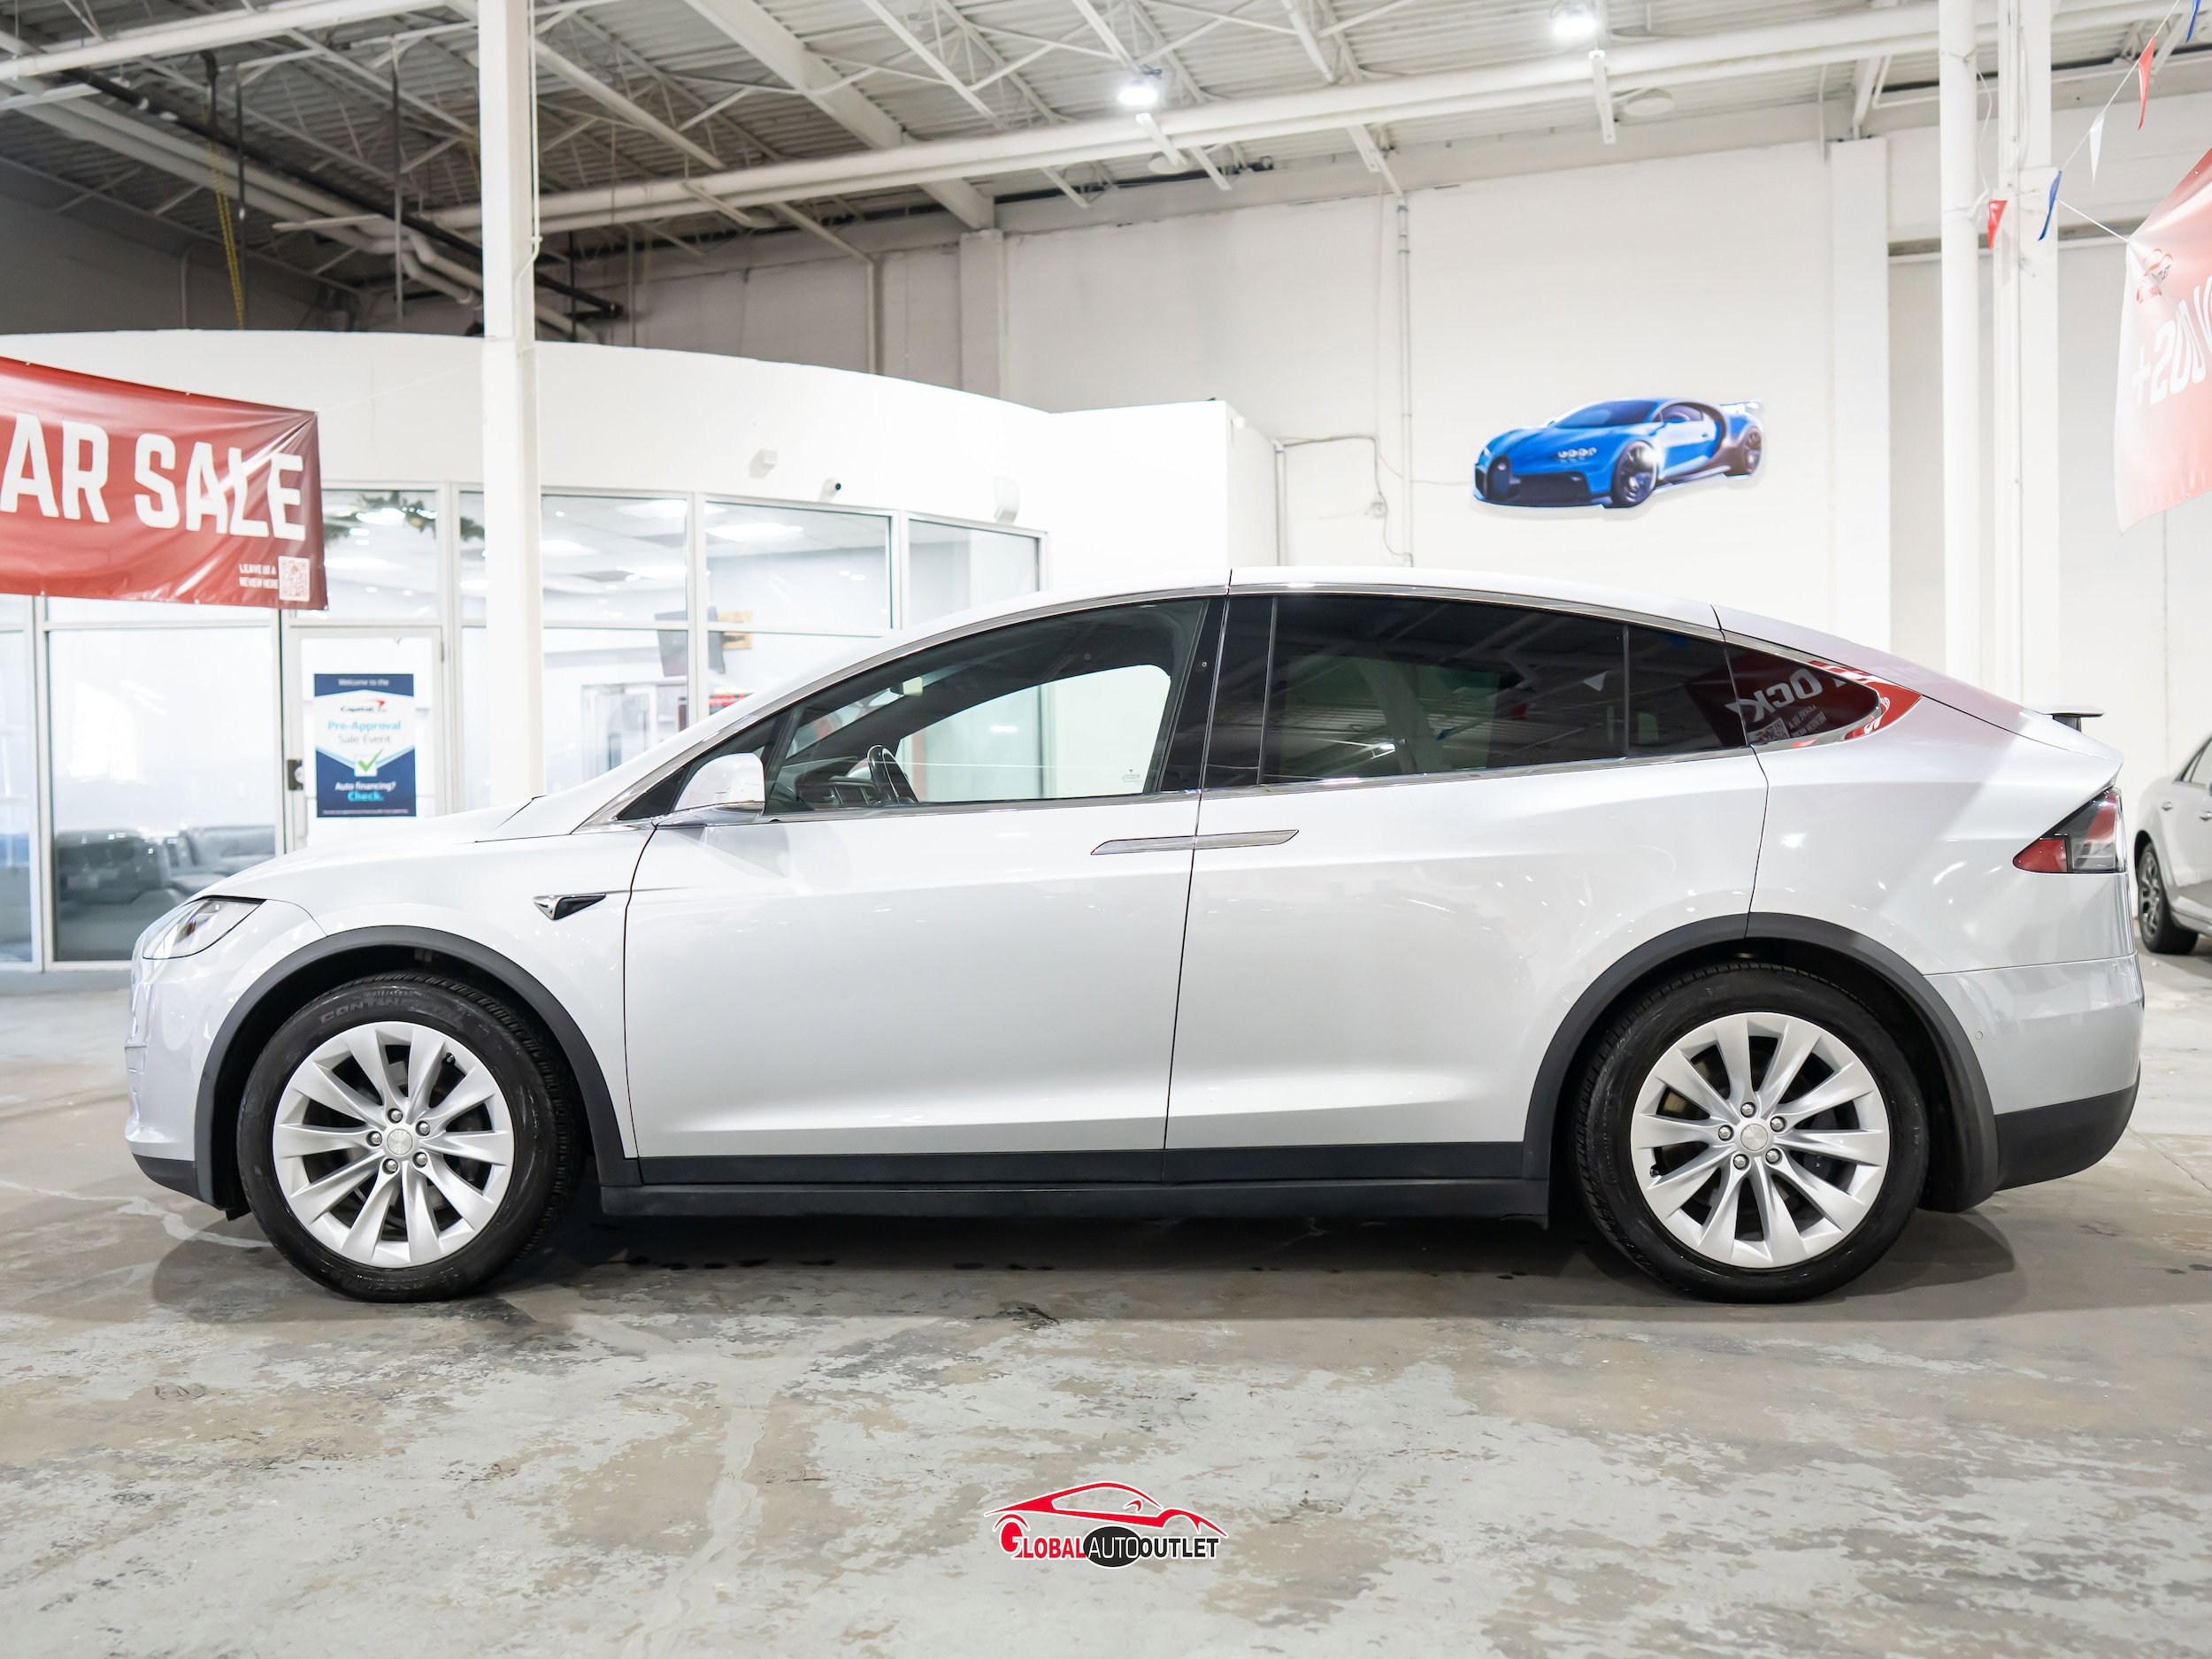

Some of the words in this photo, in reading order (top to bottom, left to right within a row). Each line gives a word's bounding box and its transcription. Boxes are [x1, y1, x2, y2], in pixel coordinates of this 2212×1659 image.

[0, 412, 110, 523] AR
[134, 434, 306, 541] SALE
[327, 721, 401, 732] Pre-Approval
[338, 734, 359, 744] Sale
[363, 735, 390, 744] Event
[334, 781, 354, 791] Auto
[355, 781, 396, 793] financing?
